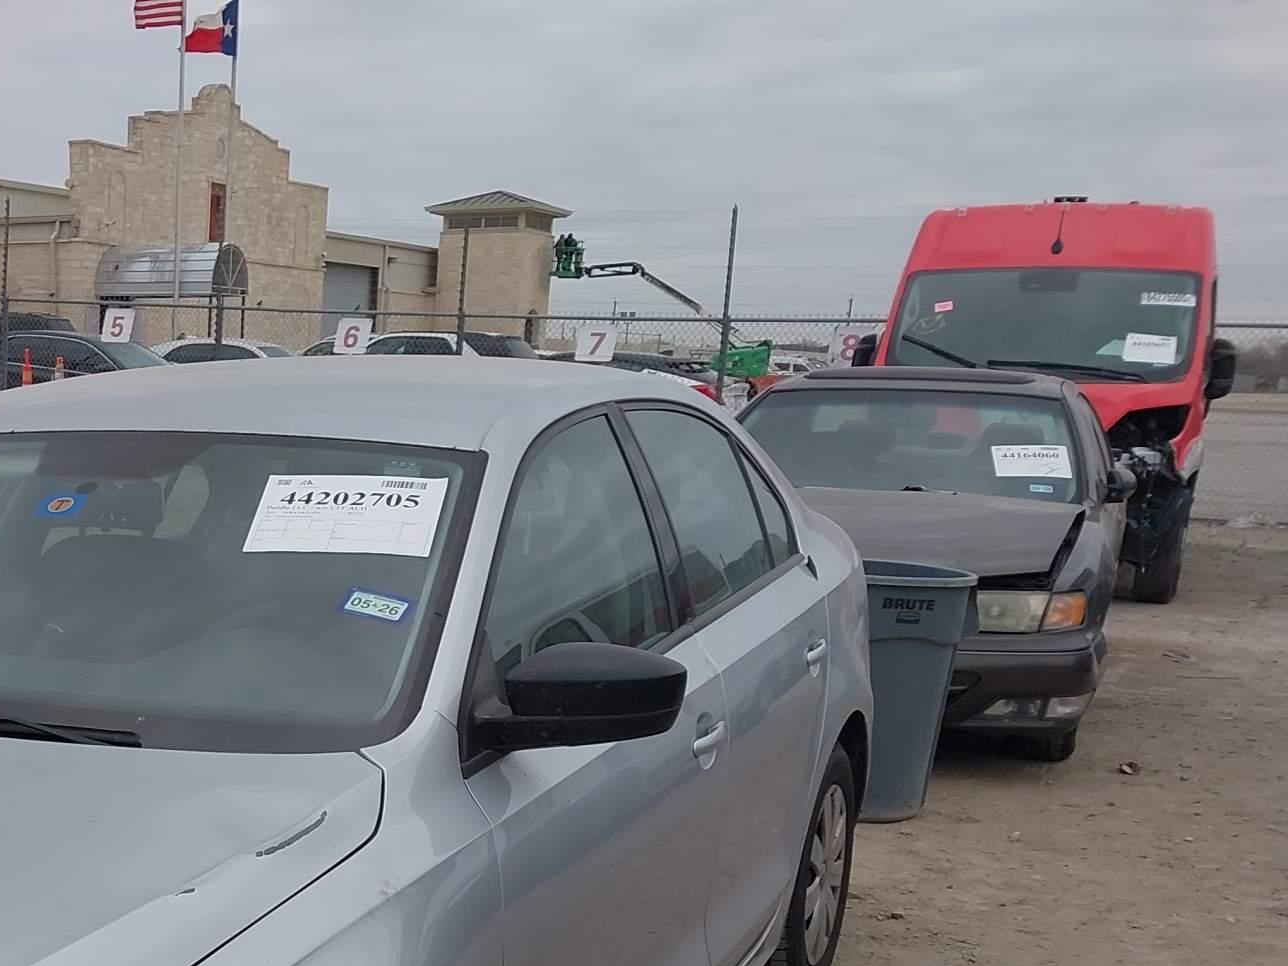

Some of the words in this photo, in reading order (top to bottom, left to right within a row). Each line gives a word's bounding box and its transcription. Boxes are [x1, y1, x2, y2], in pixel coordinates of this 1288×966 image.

[110, 316, 125, 338] 5
[343, 325, 360, 349] 6
[589, 331, 607, 355] 7
[280, 491, 421, 508] 44202705
[350, 597, 373, 609] 05
[377, 603, 401, 616] 26
[882, 597, 936, 611] BRUTE
